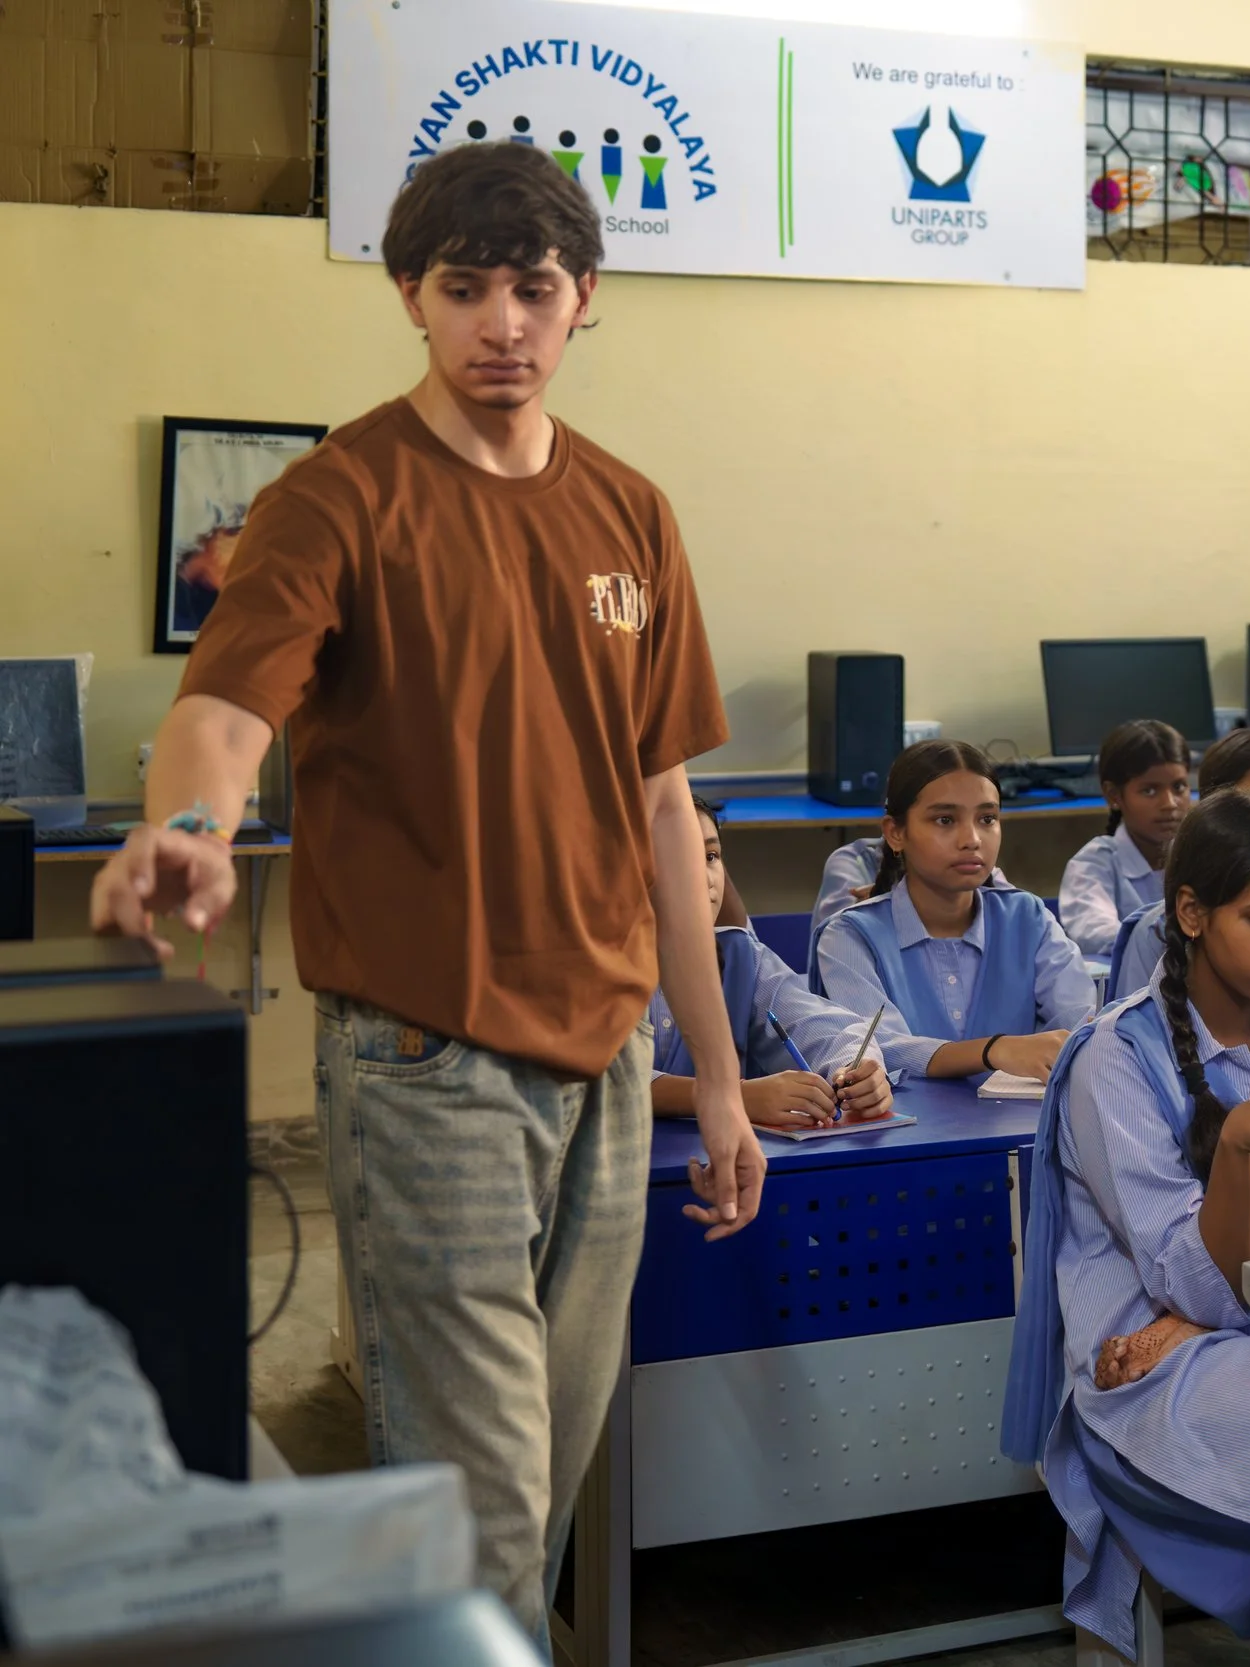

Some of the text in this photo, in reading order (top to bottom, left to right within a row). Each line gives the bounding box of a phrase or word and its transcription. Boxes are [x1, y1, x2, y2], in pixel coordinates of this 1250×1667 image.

[852, 61, 883, 81] We
[889, 68, 918, 84] are
[924, 70, 992, 90] grateful
[997, 74, 1014, 91] to
[455, 39, 579, 97] SHAKTI
[591, 44, 717, 202] VIDYALAYA
[605, 216, 669, 234] School
[891, 206, 988, 230] UNIPARTS
[911, 228, 969, 246] GROUP
